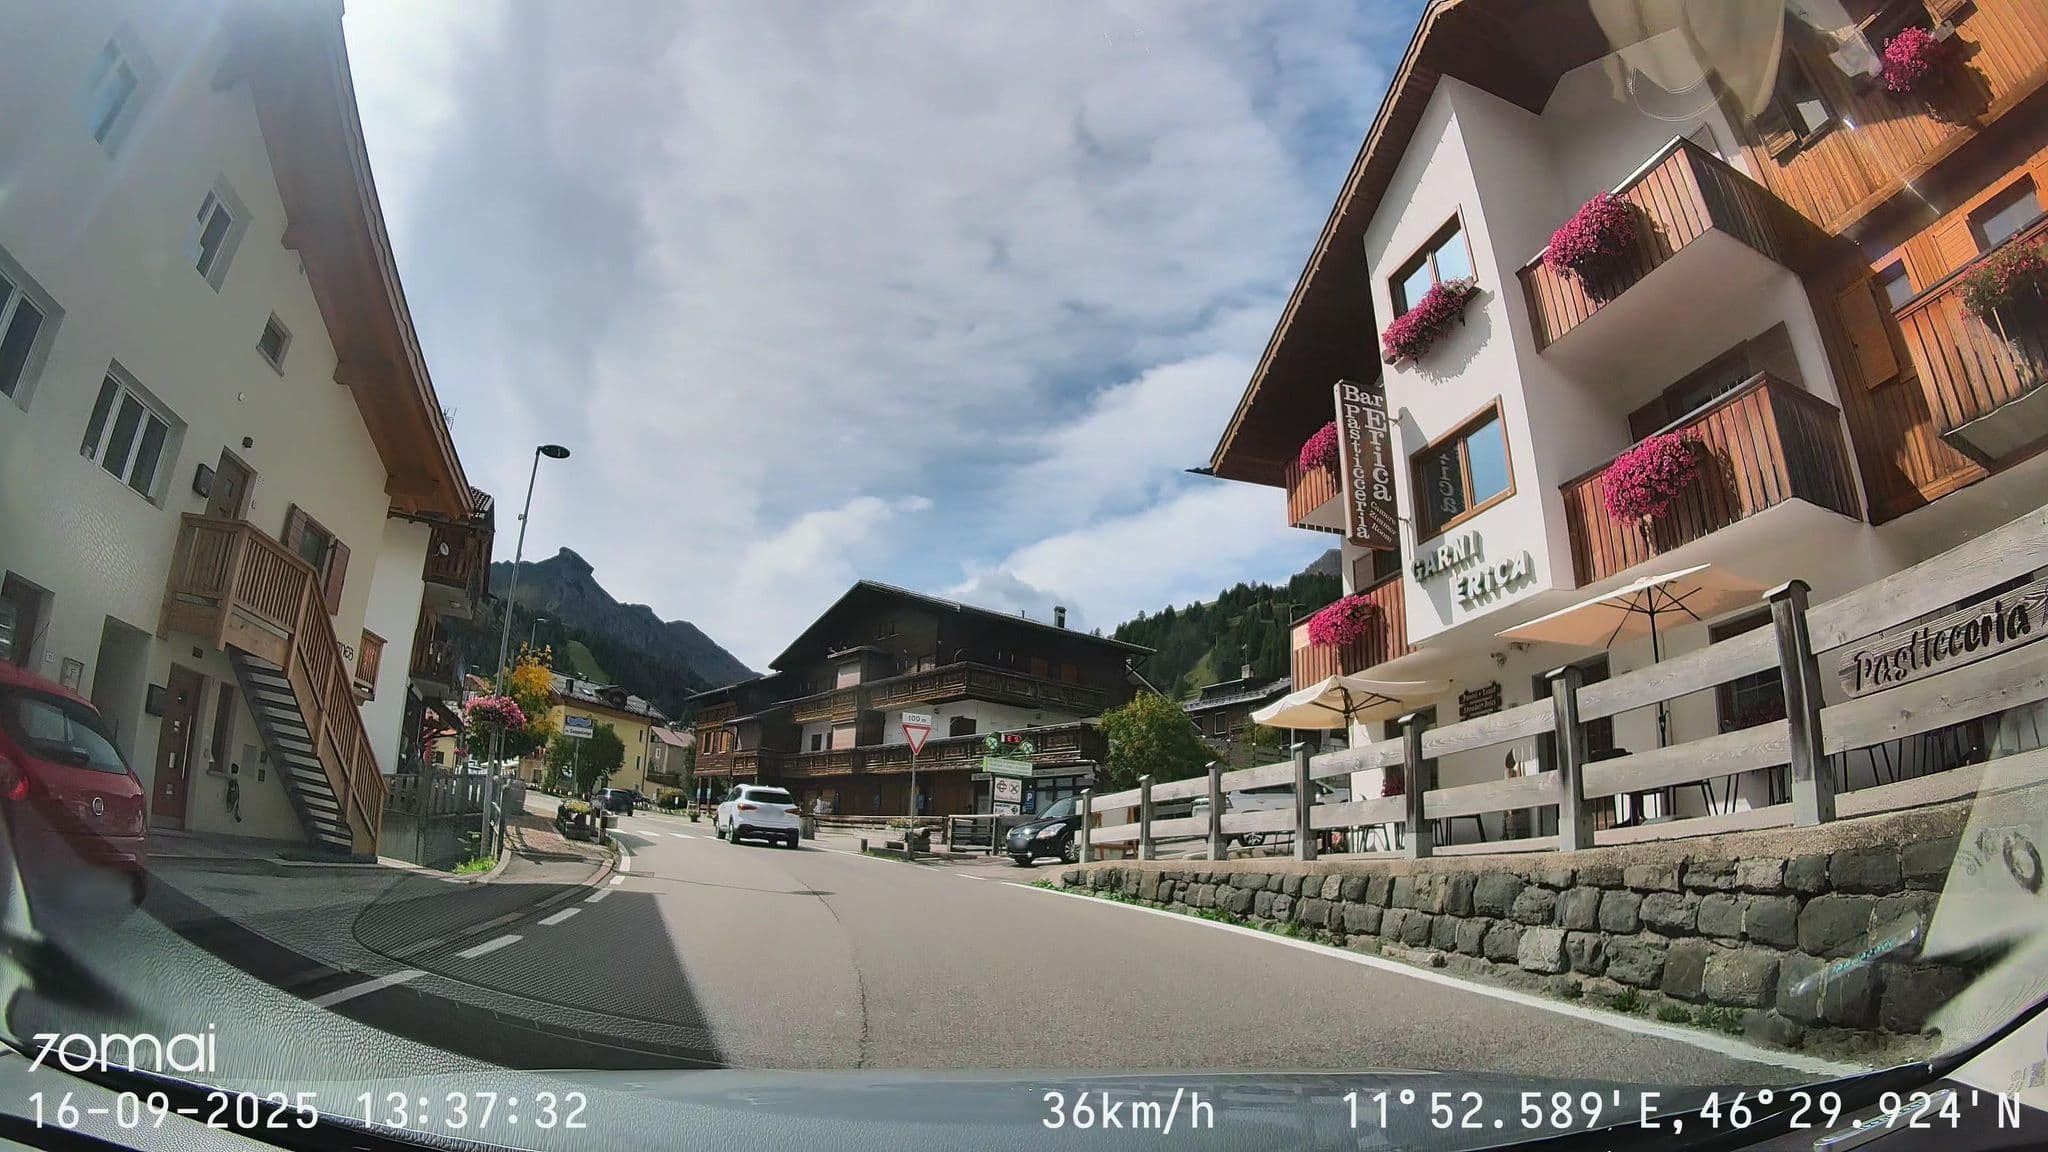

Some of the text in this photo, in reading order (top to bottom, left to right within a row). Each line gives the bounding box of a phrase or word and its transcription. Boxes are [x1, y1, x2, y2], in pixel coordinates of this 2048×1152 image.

[1342, 384, 1384, 407] Bar
[1344, 403, 1370, 540] Pasticceria
[1362, 407, 1392, 502] Erica
[1369, 511, 1397, 536] Zimmer
[1371, 522, 1393, 544] Room
[1412, 532, 1480, 581] GARNI
[1456, 551, 1530, 598] ERICA
[1026, 792, 1033, 802] P
